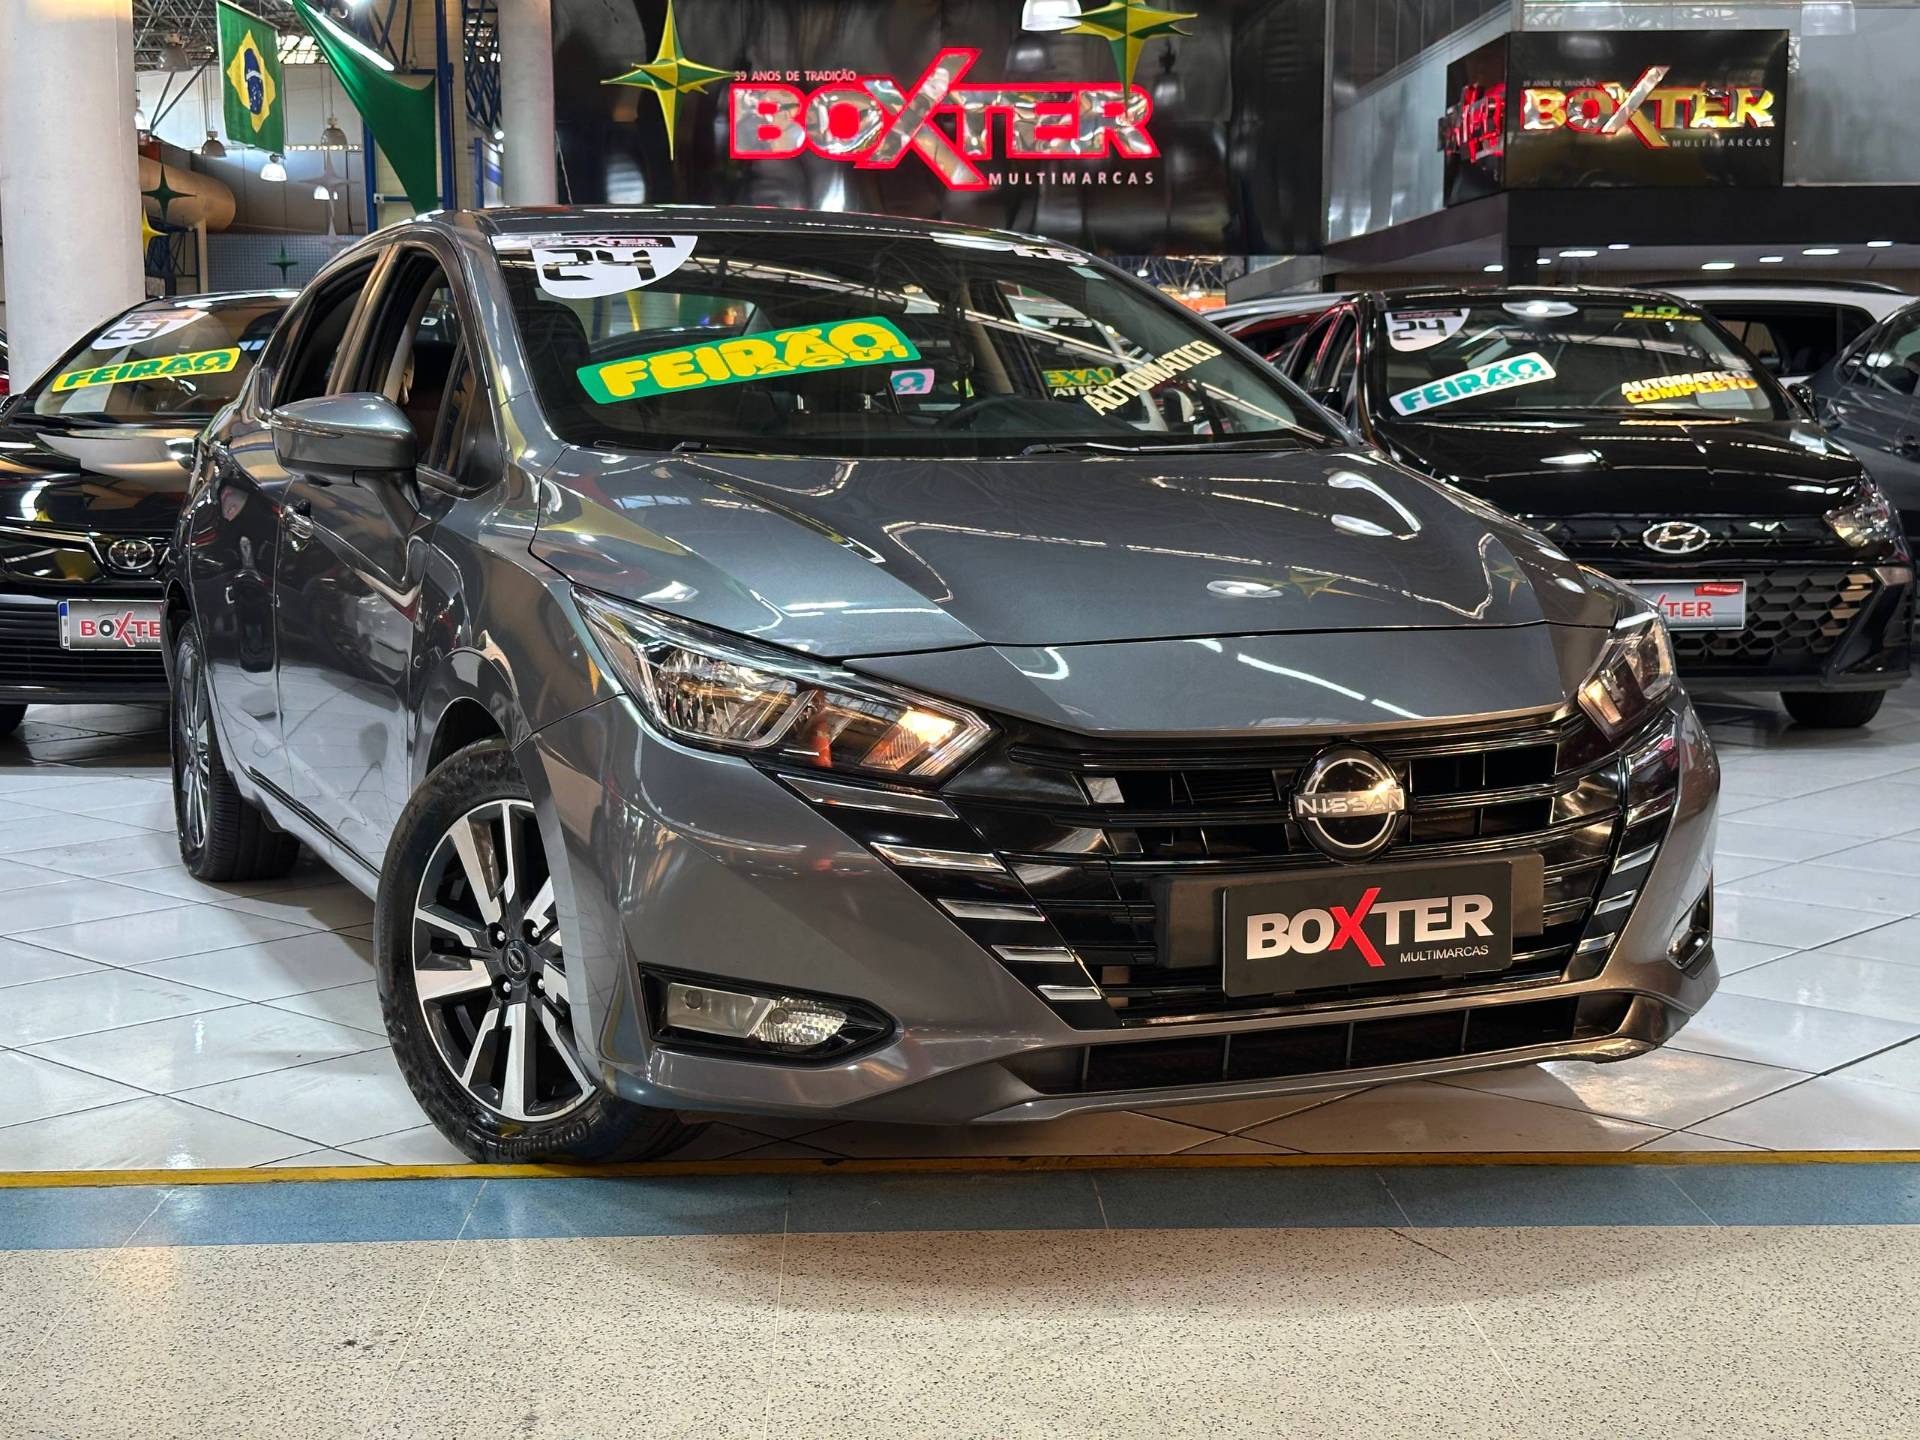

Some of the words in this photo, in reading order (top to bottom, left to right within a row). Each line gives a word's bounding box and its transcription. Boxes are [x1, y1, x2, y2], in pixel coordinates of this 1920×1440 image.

[751, 70, 781, 81] ANOS
[786, 70, 800, 81] DE
[804, 68, 857, 82] TRADIÇÃO
[730, 47, 1160, 191] BOXTER
[1520, 65, 1776, 149] BOXTER
[1672, 138, 1771, 148] MULTIMARCAS
[988, 171, 1154, 185] MULTIMARCAS
[542, 249, 656, 281] 24
[1392, 318, 1447, 341] 24
[62, 351, 232, 388] FEIRÃO
[599, 322, 900, 397] FEIRÃO
[1400, 358, 1542, 411] FEIRÃO
[1625, 377, 1758, 404] COMPLETO
[1299, 793, 1404, 815] NISSAN
[1246, 886, 1495, 968] BOXTER
[1400, 945, 1489, 963] MULTIMARCAS
